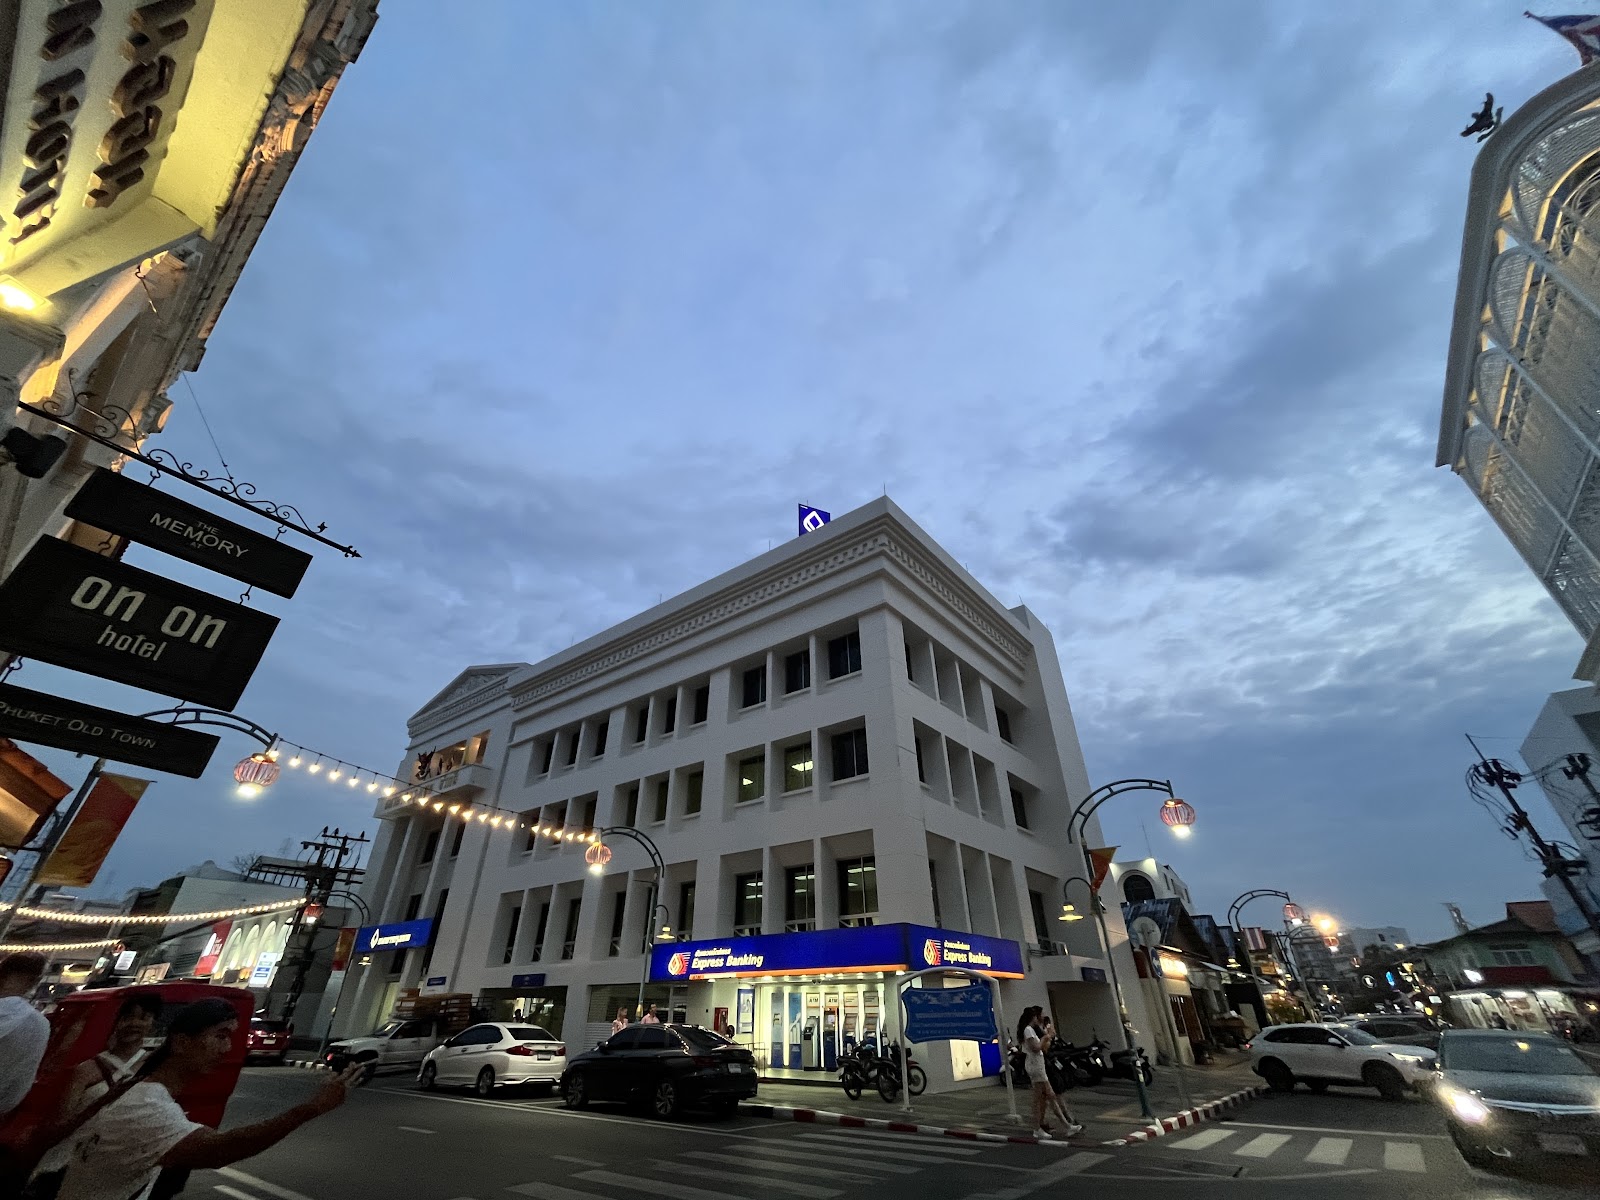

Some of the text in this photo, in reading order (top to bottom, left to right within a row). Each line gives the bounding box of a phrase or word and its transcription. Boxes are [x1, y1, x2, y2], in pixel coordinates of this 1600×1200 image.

[150, 513, 249, 558] MEMORY
[197, 521, 219, 534] THE
[190, 541, 203, 549] AT
[71, 575, 227, 649] on on
[97, 624, 168, 661] hotel
[691, 954, 764, 970] Express Banking
[943, 949, 992, 967] Express Banking
